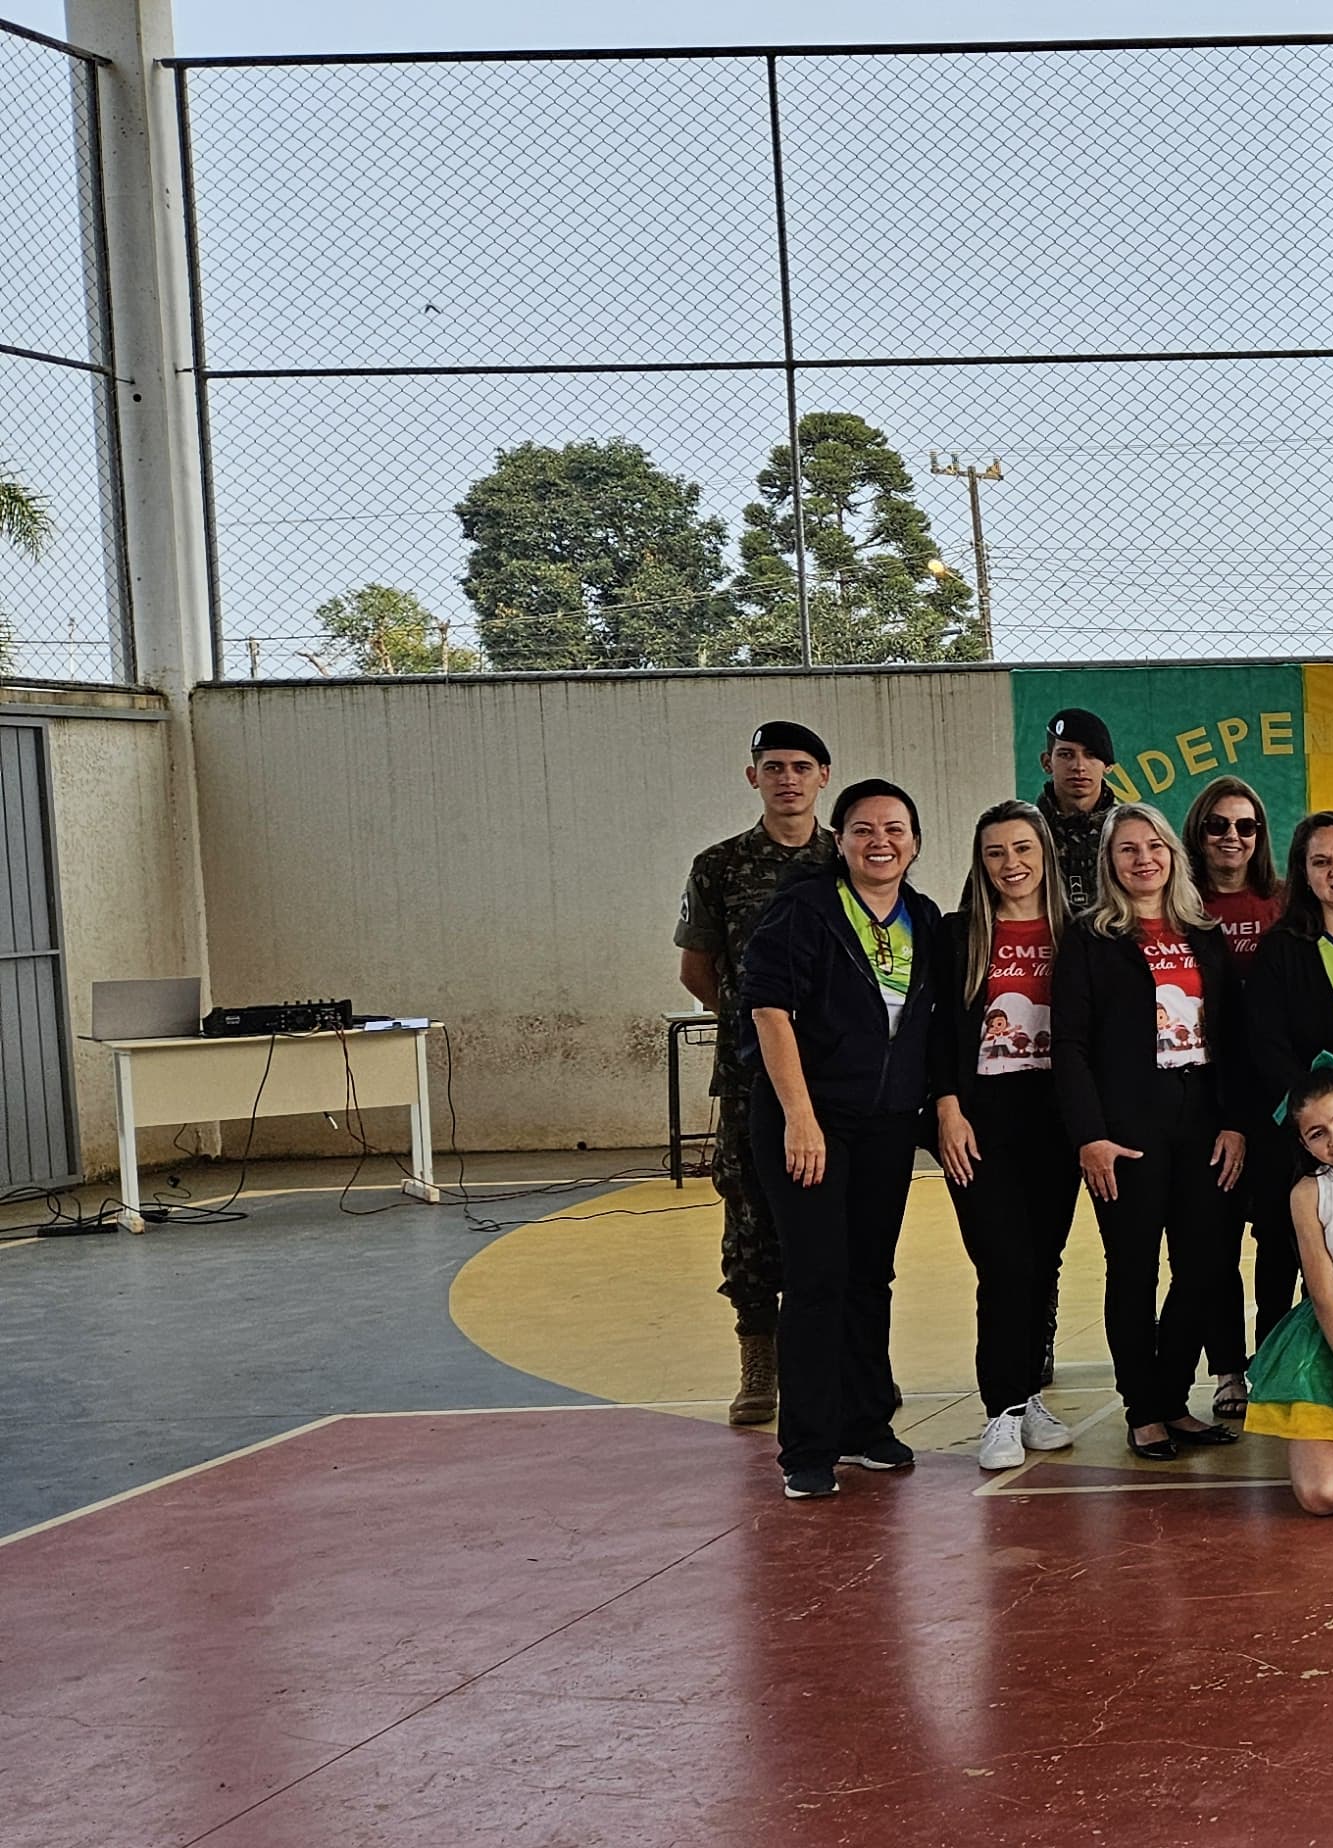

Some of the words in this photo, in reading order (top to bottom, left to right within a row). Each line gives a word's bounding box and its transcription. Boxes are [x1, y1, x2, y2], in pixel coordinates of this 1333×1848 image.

[1220, 920, 1261, 936] MEI
[998, 945, 1054, 959] CME
[1143, 943, 1193, 956] CME
